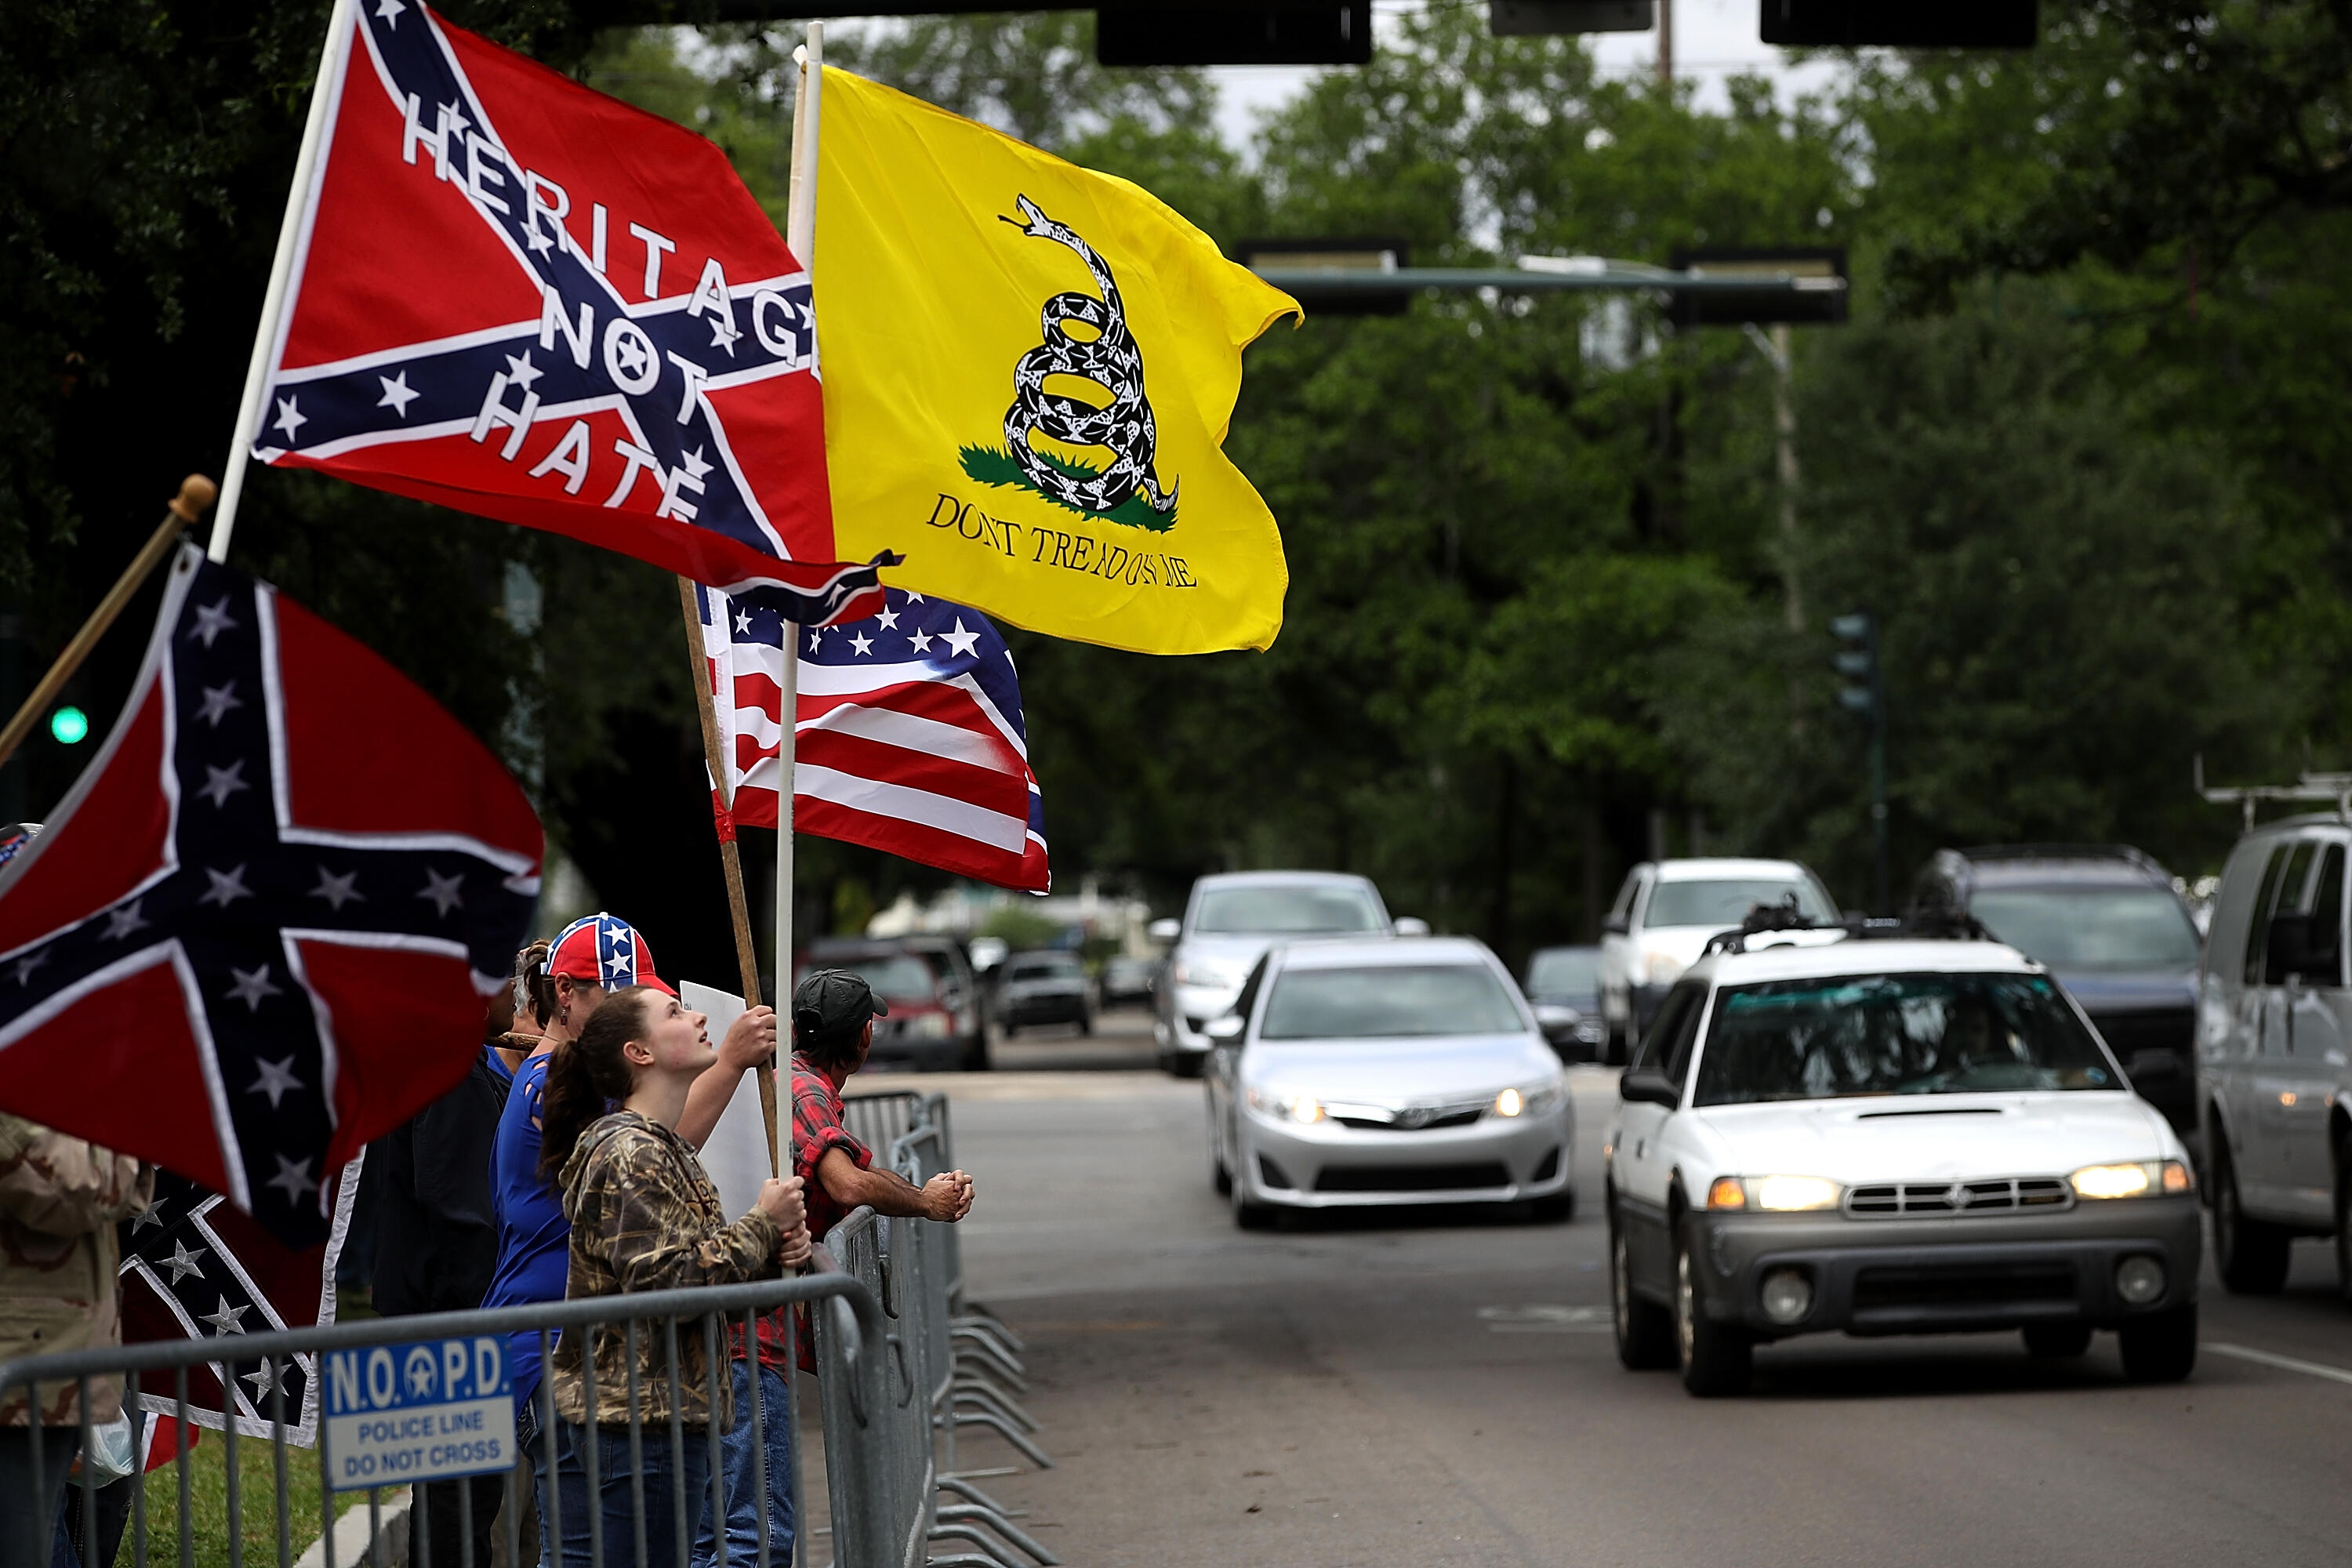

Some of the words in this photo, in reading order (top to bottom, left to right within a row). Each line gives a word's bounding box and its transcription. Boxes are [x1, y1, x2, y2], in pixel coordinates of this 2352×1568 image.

[539, 284, 708, 426] NOT
[1030, 527, 1128, 580] TREAD
[1126, 552, 1157, 586] ON
[1159, 554, 1197, 588] ME
[331, 1346, 401, 1414] N.O.
[443, 1336, 510, 1401] P.D.
[344, 1454, 376, 1477] DO
[382, 1449, 424, 1472] NOT
[429, 1438, 502, 1467] CROSS
[358, 1414, 434, 1446] POLICE
[440, 1409, 485, 1435] LINE
